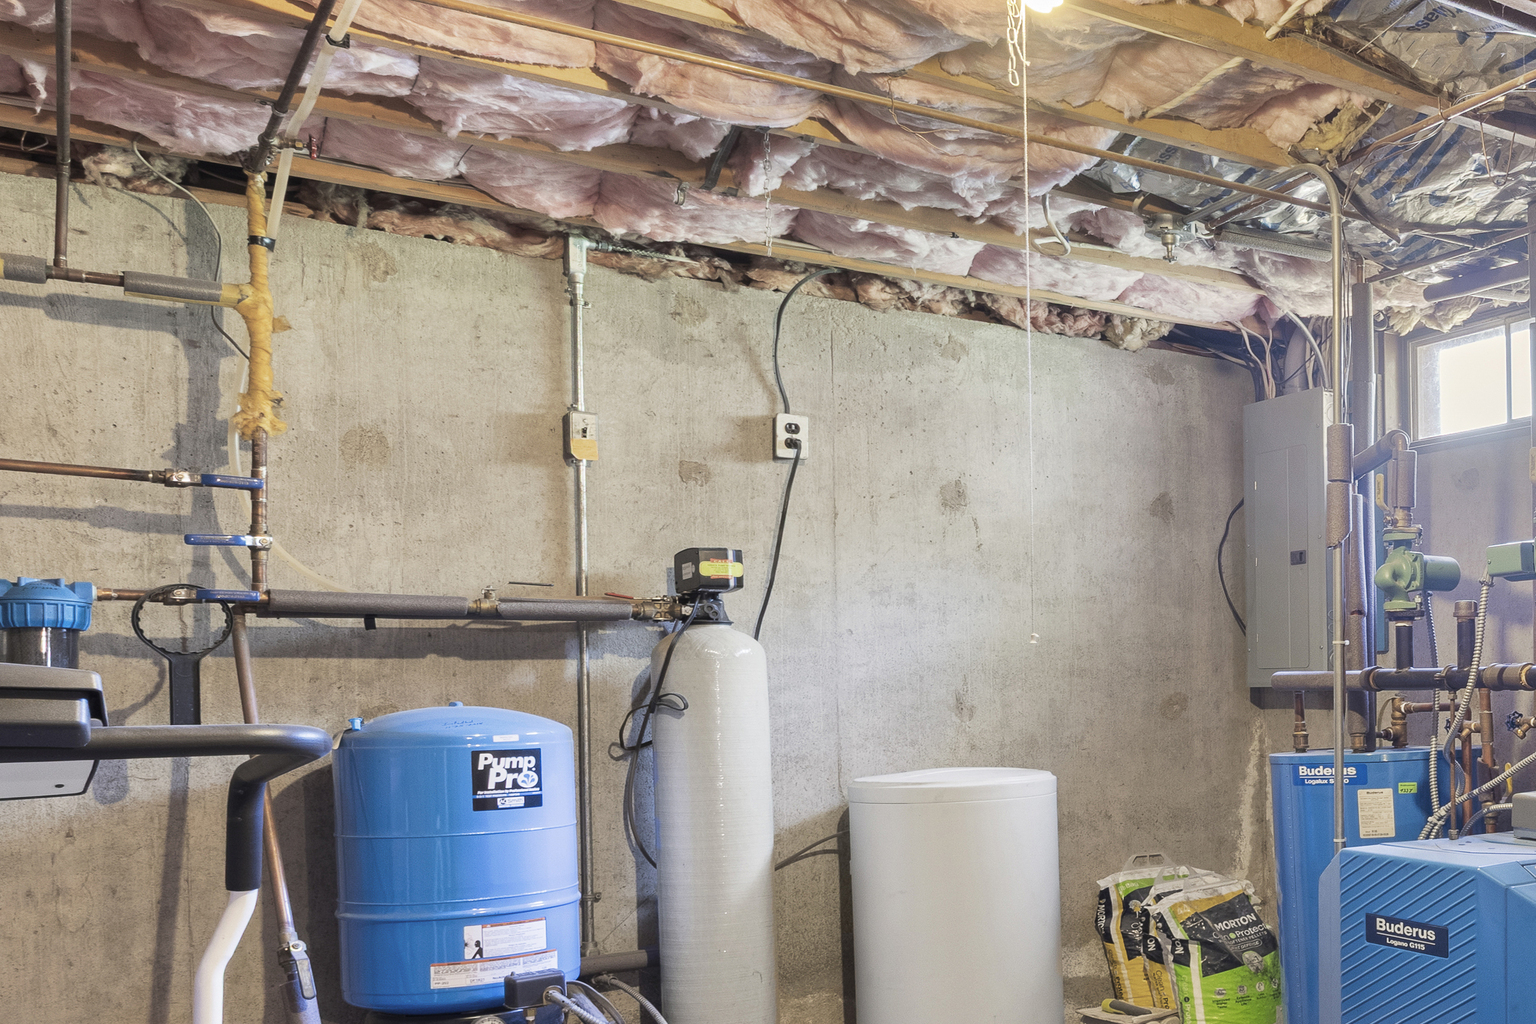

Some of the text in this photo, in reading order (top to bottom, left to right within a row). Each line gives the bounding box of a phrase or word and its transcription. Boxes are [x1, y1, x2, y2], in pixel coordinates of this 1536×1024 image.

[478, 752, 536, 773] Pump
[1298, 765, 1357, 777] Budes
[488, 767, 539, 790] Pro
[1213, 912, 1257, 931] MORTON
[1376, 917, 1436, 941] Buderus
[1386, 937, 1426, 951] Logano G115
